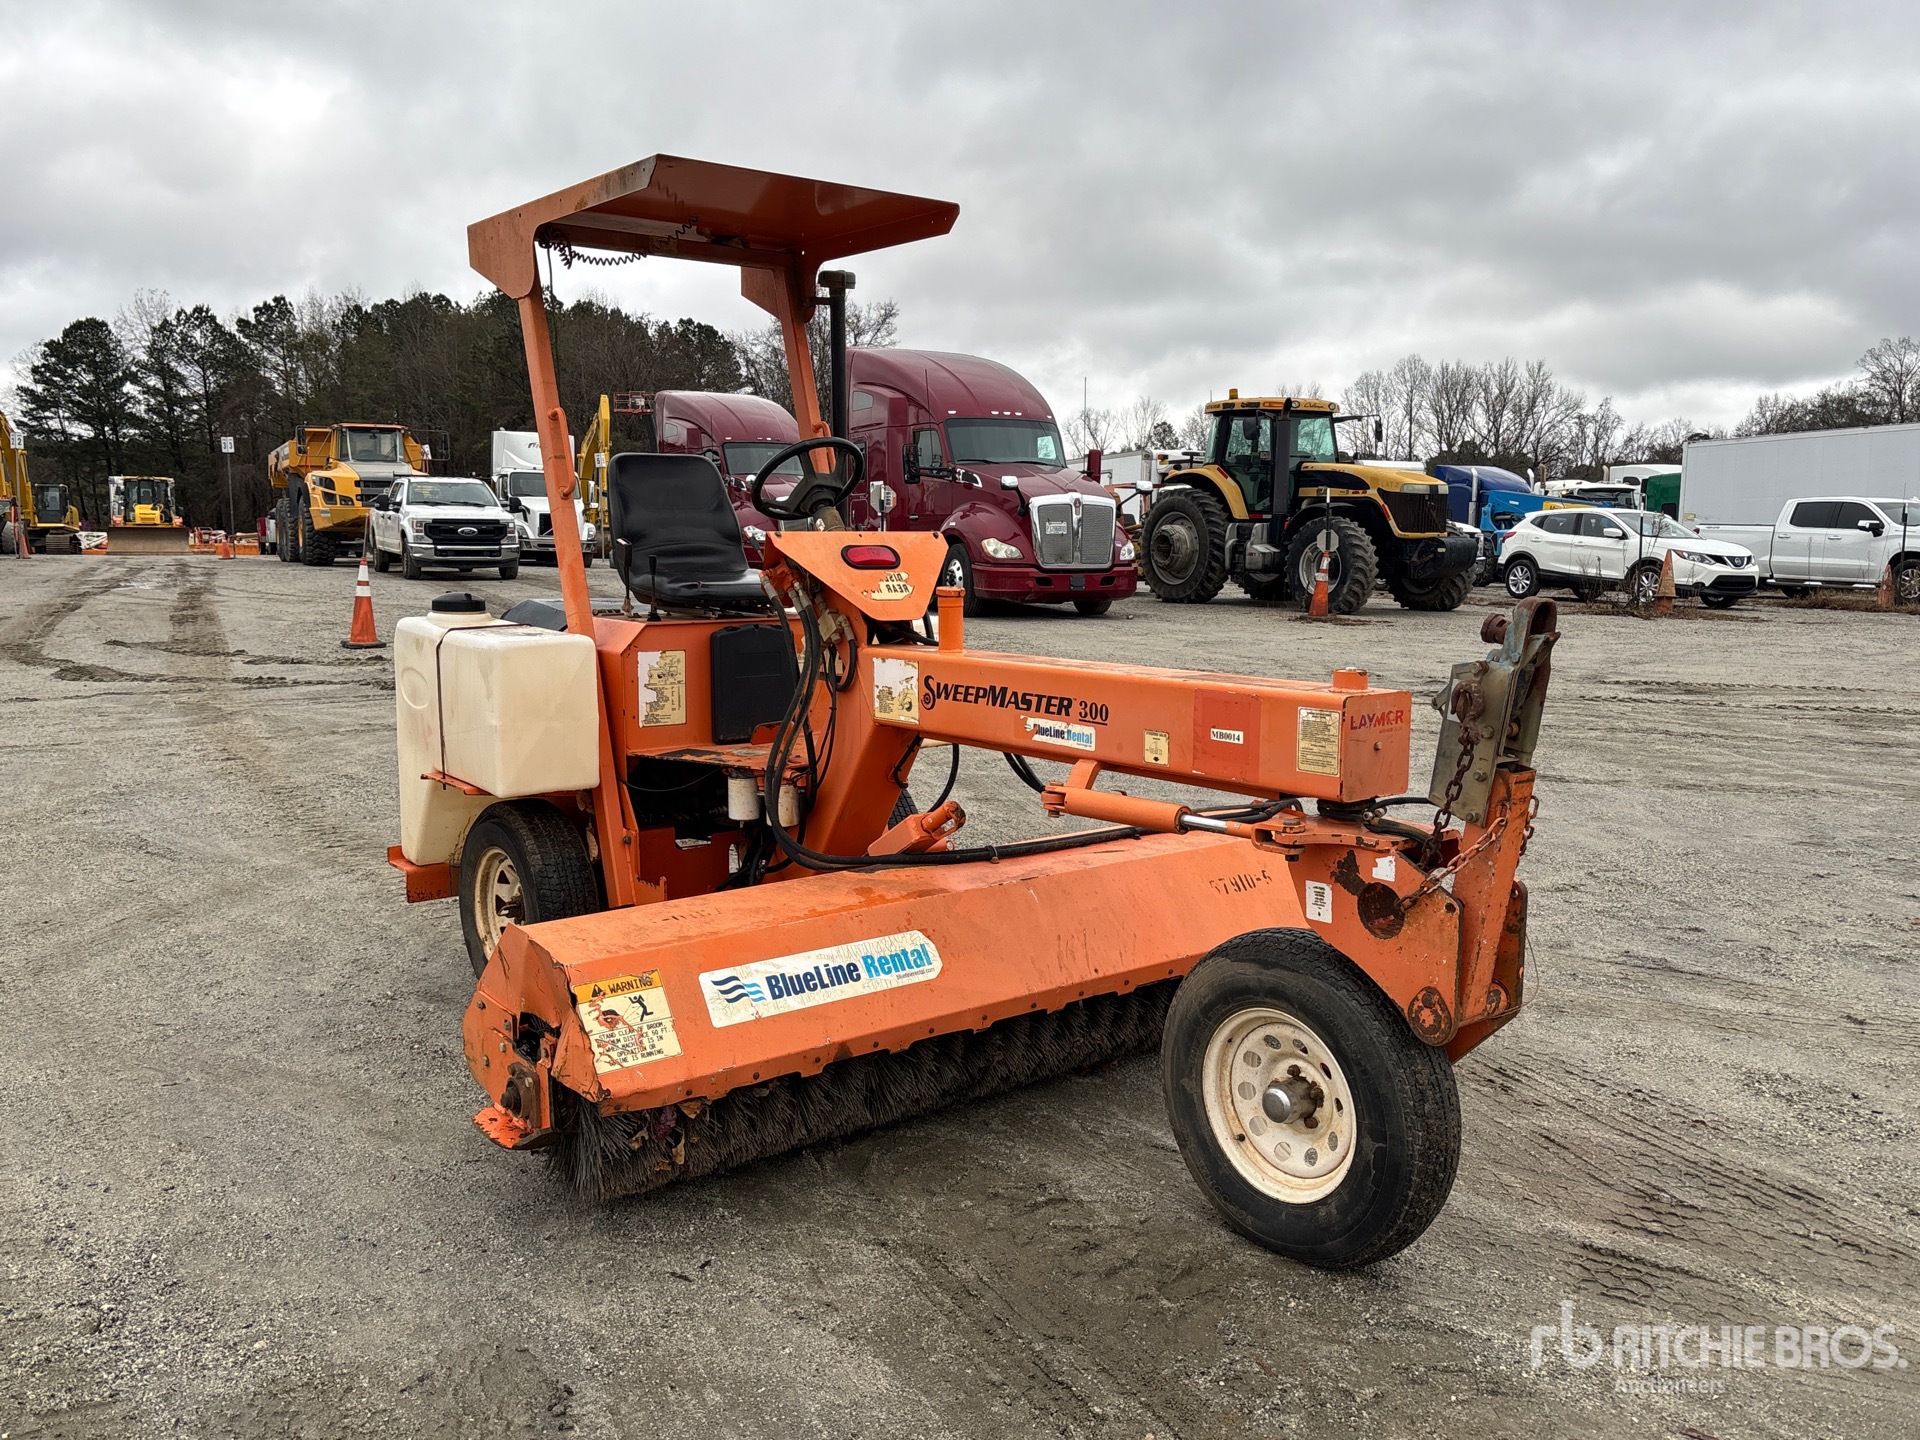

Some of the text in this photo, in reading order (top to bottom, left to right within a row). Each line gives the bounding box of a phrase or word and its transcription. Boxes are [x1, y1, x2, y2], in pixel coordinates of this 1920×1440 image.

[1078, 700, 1110, 723] 300
[1066, 727, 1093, 744] Rental
[1211, 730, 1240, 742] MB0014
[764, 943, 933, 1000] BlueLine Rental
[607, 976, 653, 994] WARNING
[598, 1032, 617, 1041] STAND
